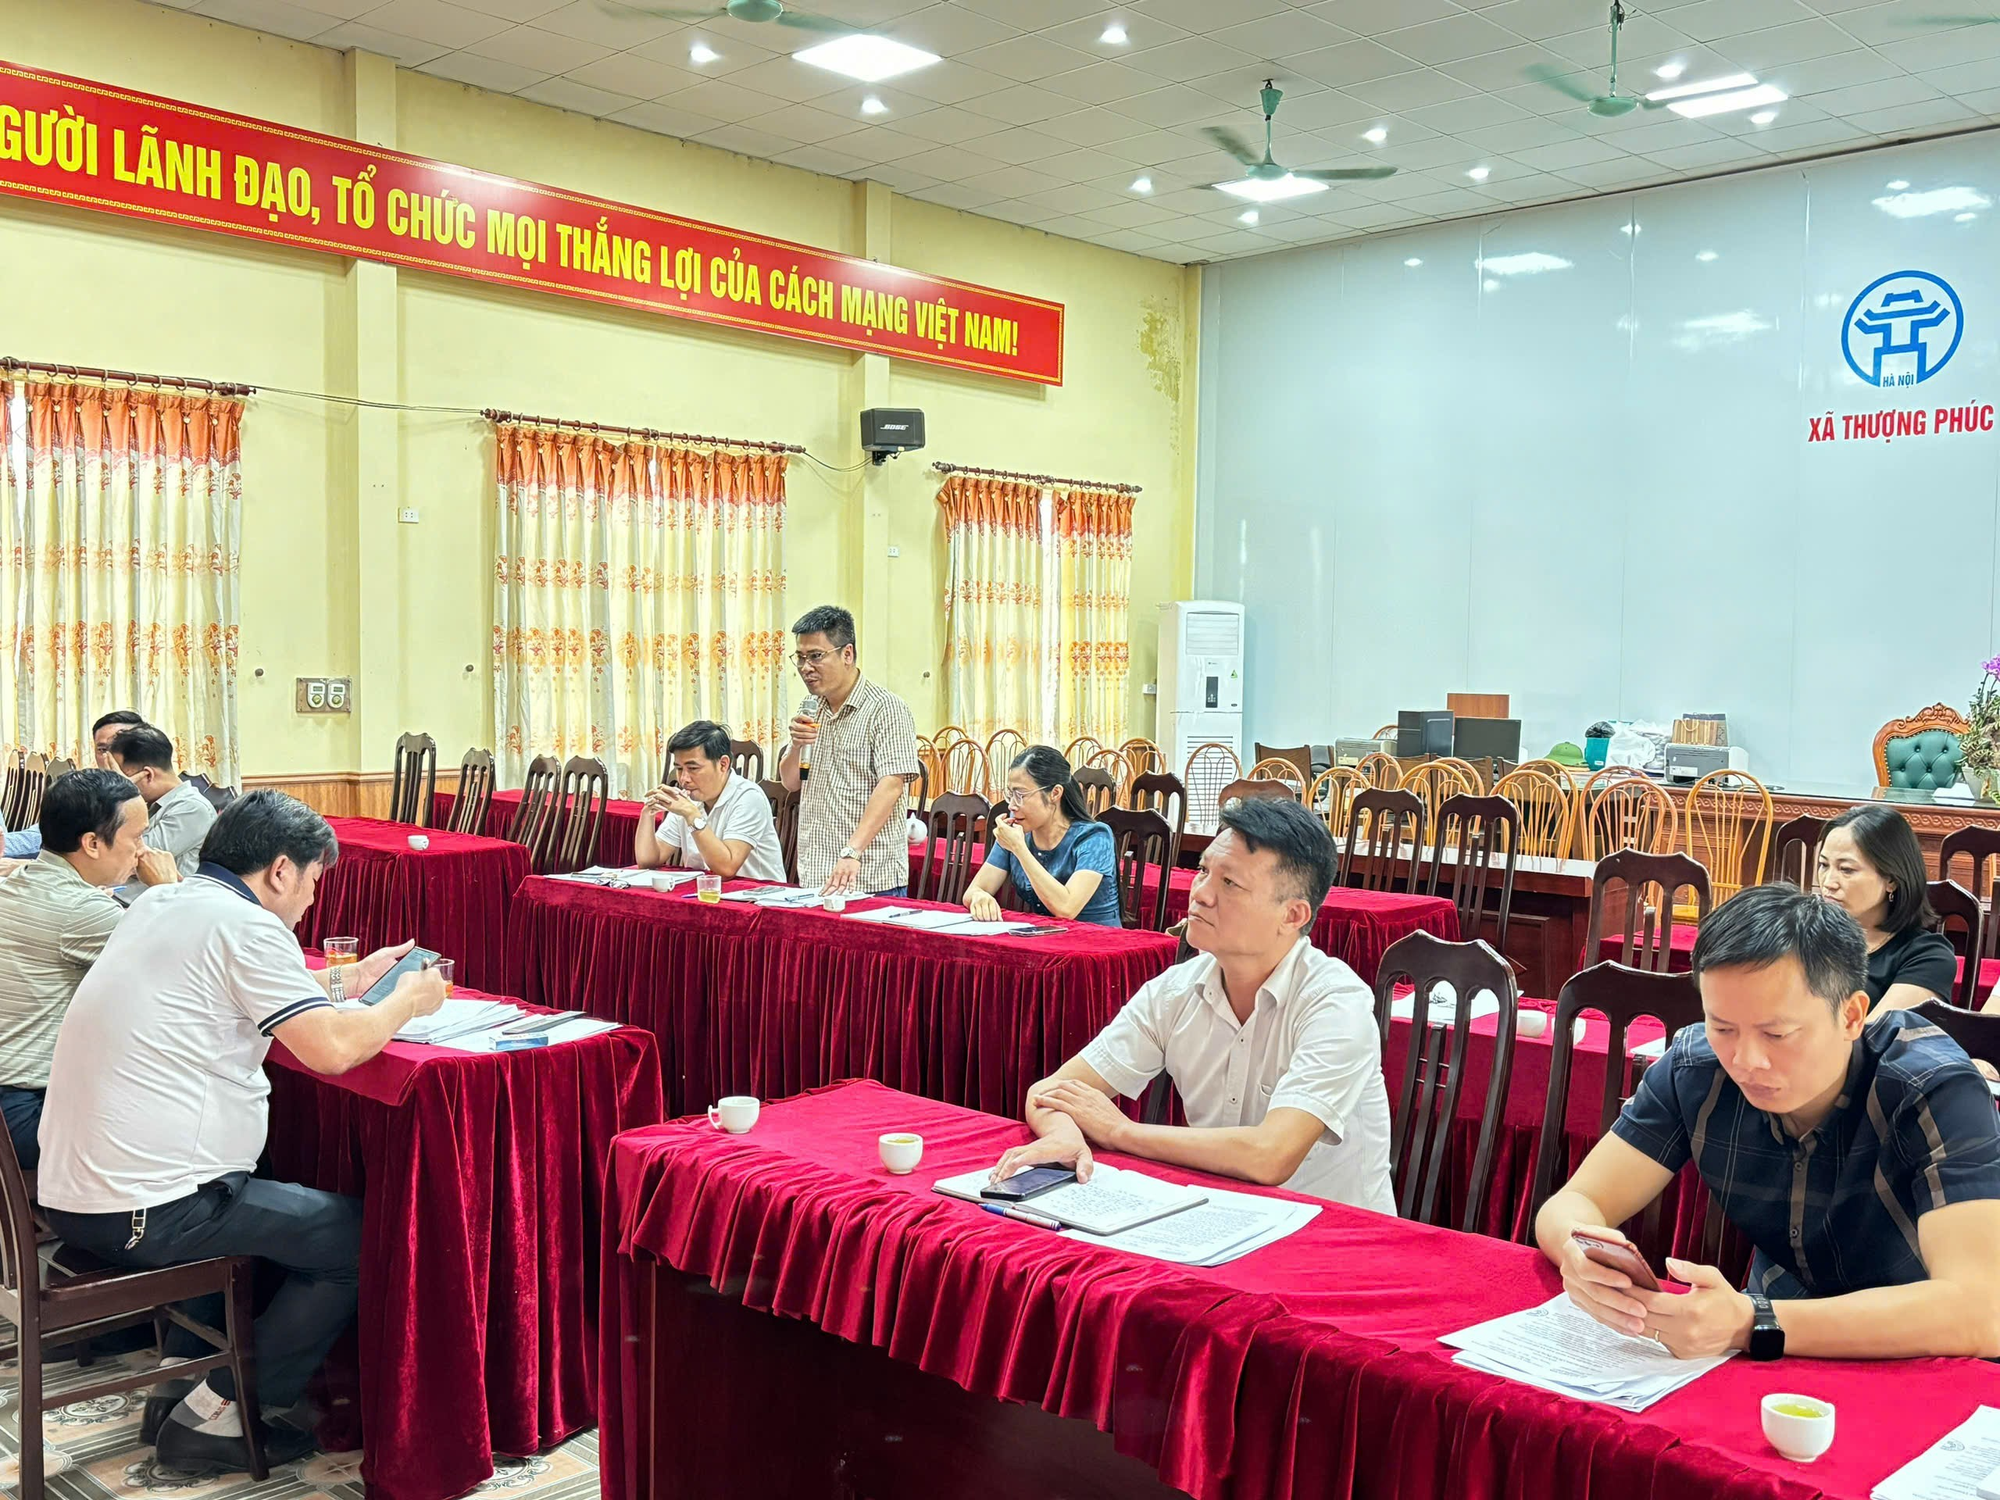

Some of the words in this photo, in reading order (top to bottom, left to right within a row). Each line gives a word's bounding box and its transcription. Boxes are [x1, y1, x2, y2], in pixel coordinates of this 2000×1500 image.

[0, 104, 98, 176] GƯỜI
[114, 126, 221, 199] LÃNH
[233, 155, 320, 225] ĐẠO,
[333, 164, 377, 229] TỔ
[388, 188, 475, 249] CHỨC
[486, 209, 547, 269] MỌI
[556, 216, 651, 283] THẮNG
[660, 244, 701, 299] LỢI
[710, 249, 761, 305] CỦA
[769, 265, 834, 319] CÁCH
[842, 285, 908, 336] MẠNG
[915, 297, 959, 349] VIỆT
[965, 313, 1018, 356] NAM!
[1882, 373, 1895, 387] HÀ
[1898, 371, 1914, 388] NỘI
[1808, 411, 1835, 442] XÃ
[1842, 409, 1927, 443] THƯỢNG
[1934, 399, 1994, 434] PHÚC
